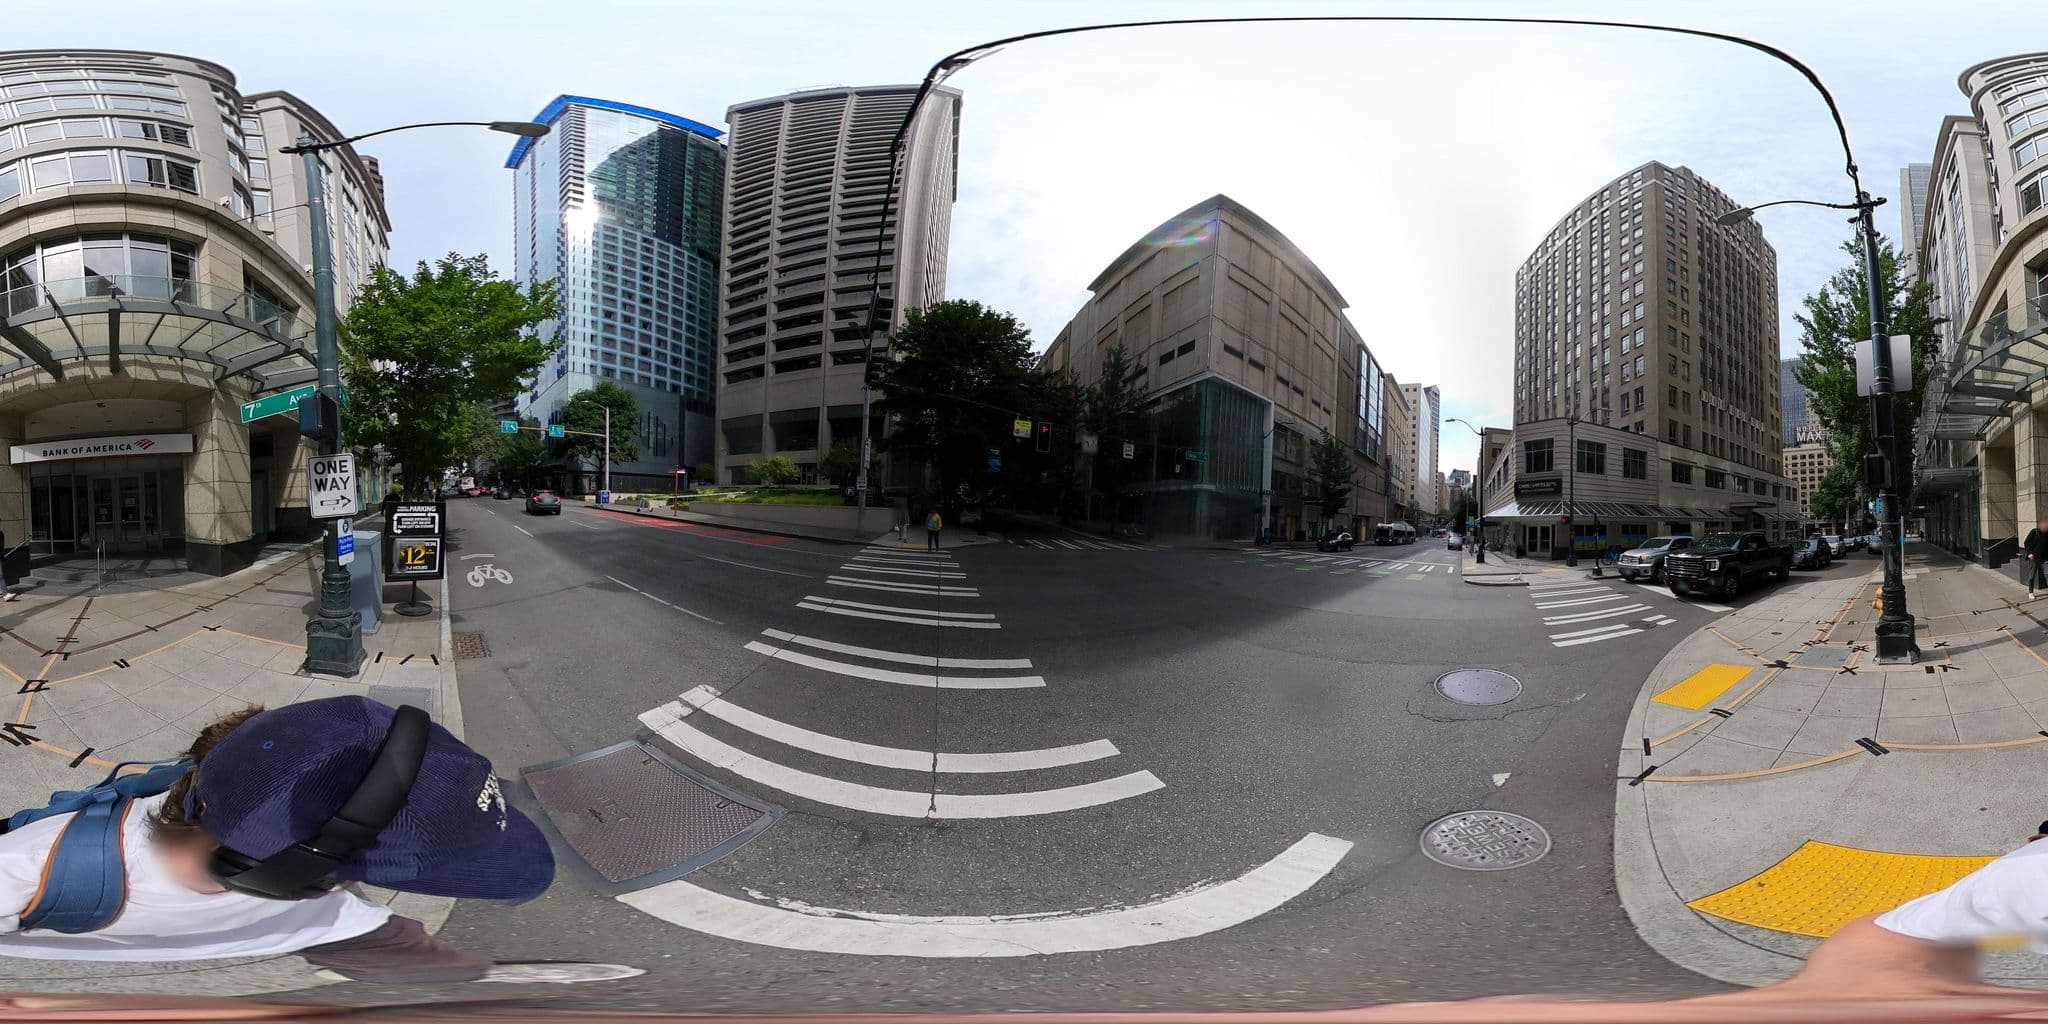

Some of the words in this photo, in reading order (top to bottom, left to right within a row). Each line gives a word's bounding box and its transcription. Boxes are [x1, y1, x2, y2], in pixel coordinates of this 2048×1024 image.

[1796, 431, 1822, 441] MAX
[43, 448, 69, 457] BANK
[71, 446, 84, 454] OF
[86, 444, 132, 453] AMERICA
[314, 460, 348, 475] ONE
[314, 476, 350, 492] WAY
